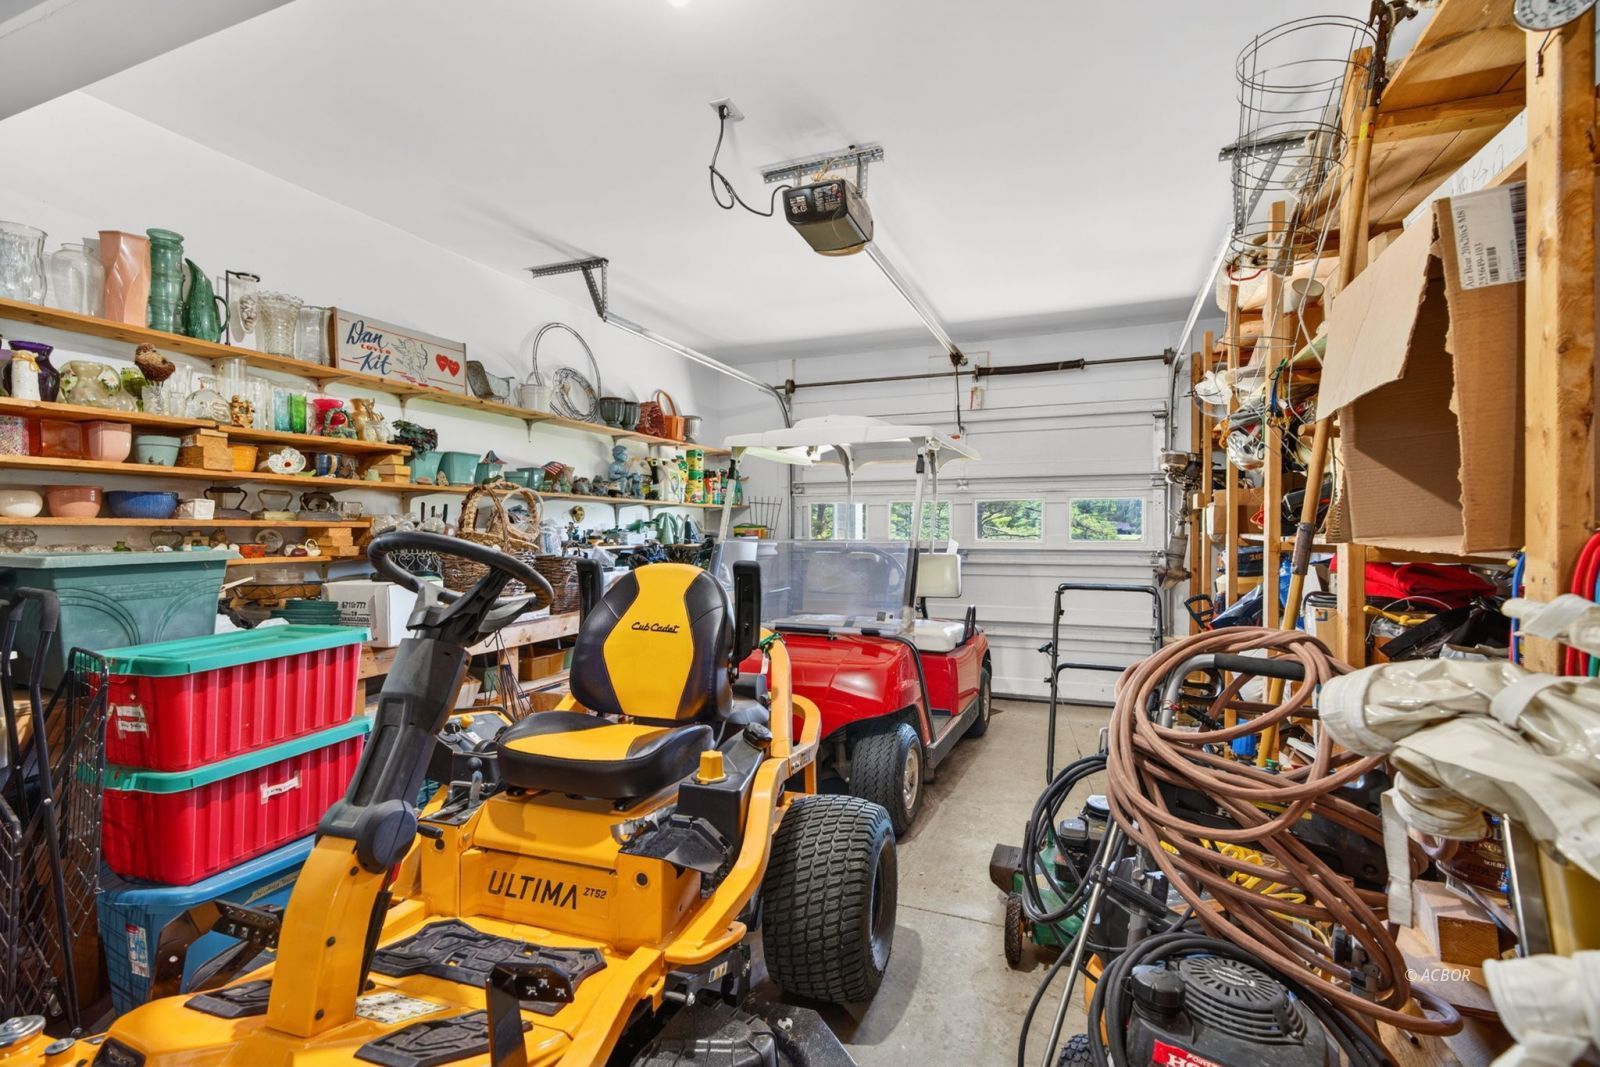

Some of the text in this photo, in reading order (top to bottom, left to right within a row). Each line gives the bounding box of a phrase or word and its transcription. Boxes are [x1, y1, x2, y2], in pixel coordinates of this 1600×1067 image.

[346, 320, 389, 349] Dan
[352, 351, 394, 375] Kit
[631, 621, 680, 634] Cub Cadet
[488, 870, 607, 910] ULTIMA ZT52
